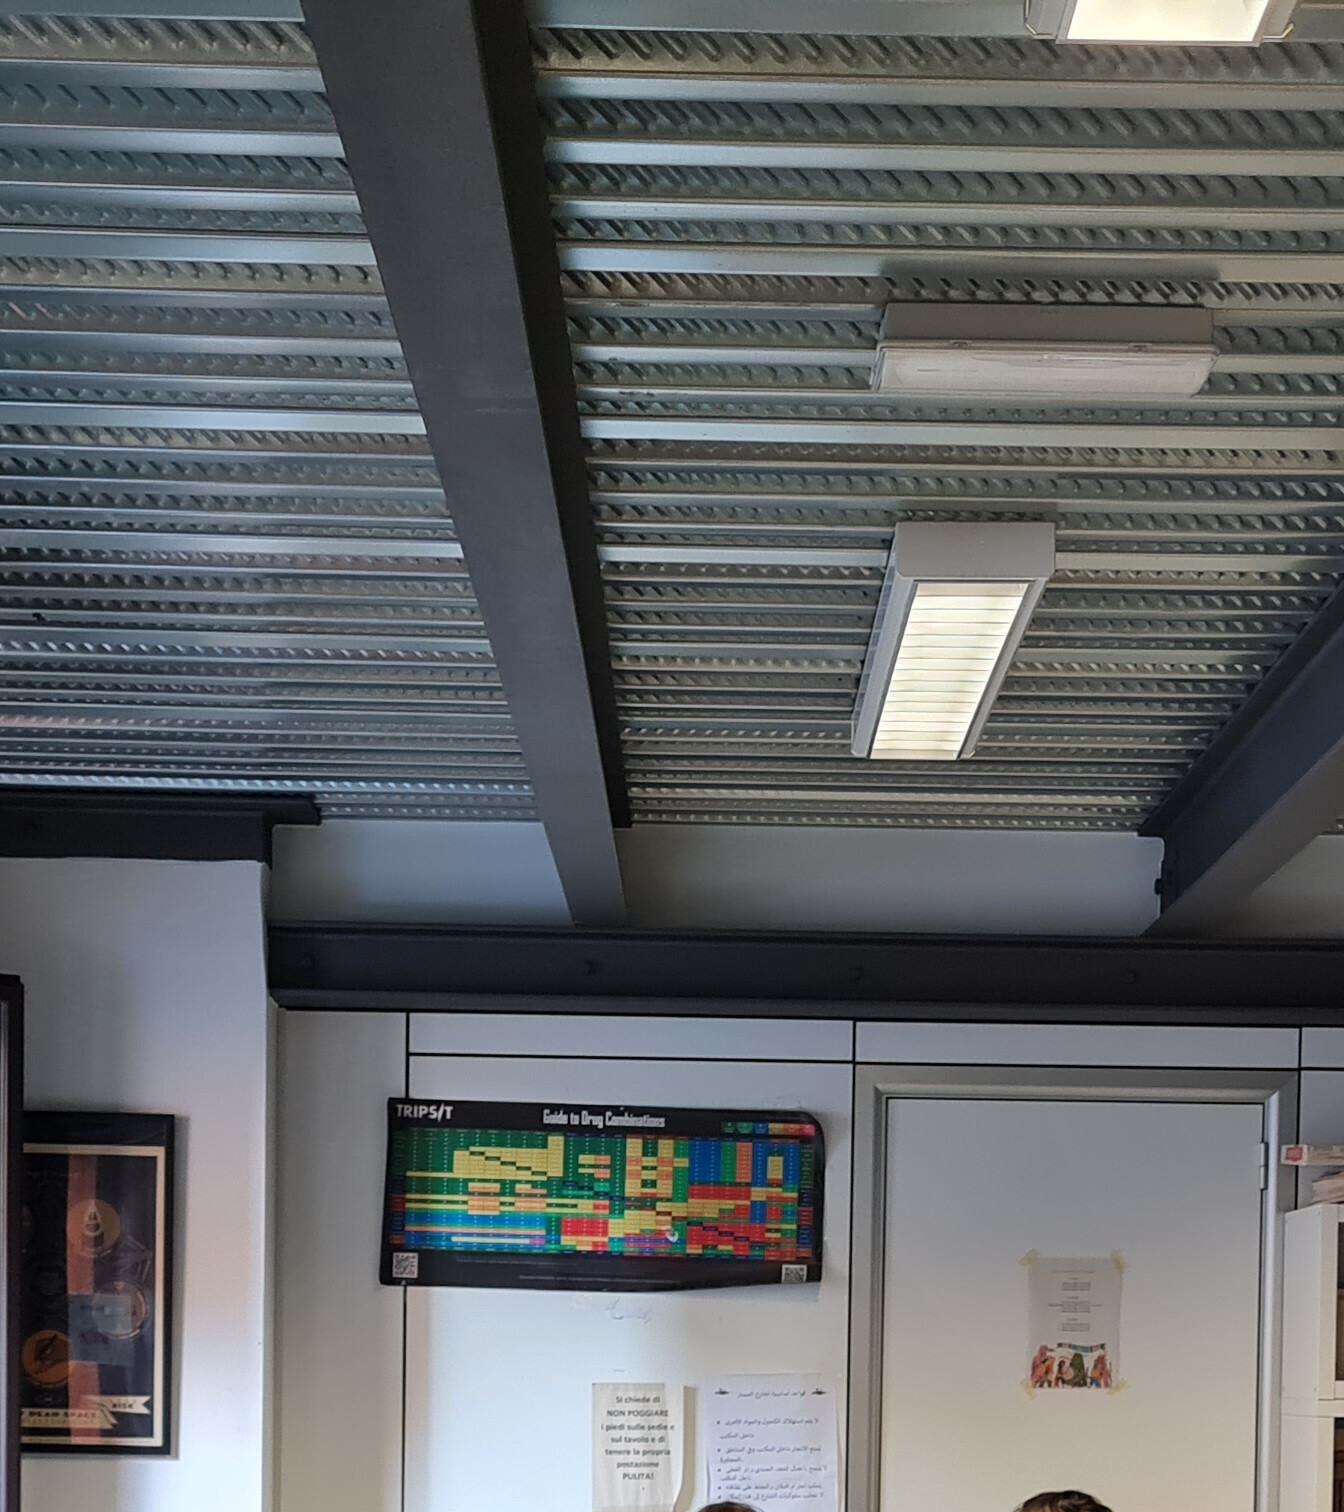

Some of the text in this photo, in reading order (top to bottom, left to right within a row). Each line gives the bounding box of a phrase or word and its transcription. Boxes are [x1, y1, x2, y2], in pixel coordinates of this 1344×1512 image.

[542, 1108, 666, 1129] Guide to Drug Combinations
[624, 1395, 651, 1404] chiede
[606, 1409, 669, 1417] NON POGGIARE
[605, 1423, 625, 1432] piedi
[627, 1423, 645, 1431] sulle
[647, 1423, 668, 1431] sedie
[610, 1435, 622, 1443] sul
[624, 1435, 650, 1443] tavolo
[657, 1435, 666, 1443] di
[642, 1448, 671, 1457] propria
[616, 1461, 660, 1469] postazione
[622, 1472, 654, 1480] PULITA!
